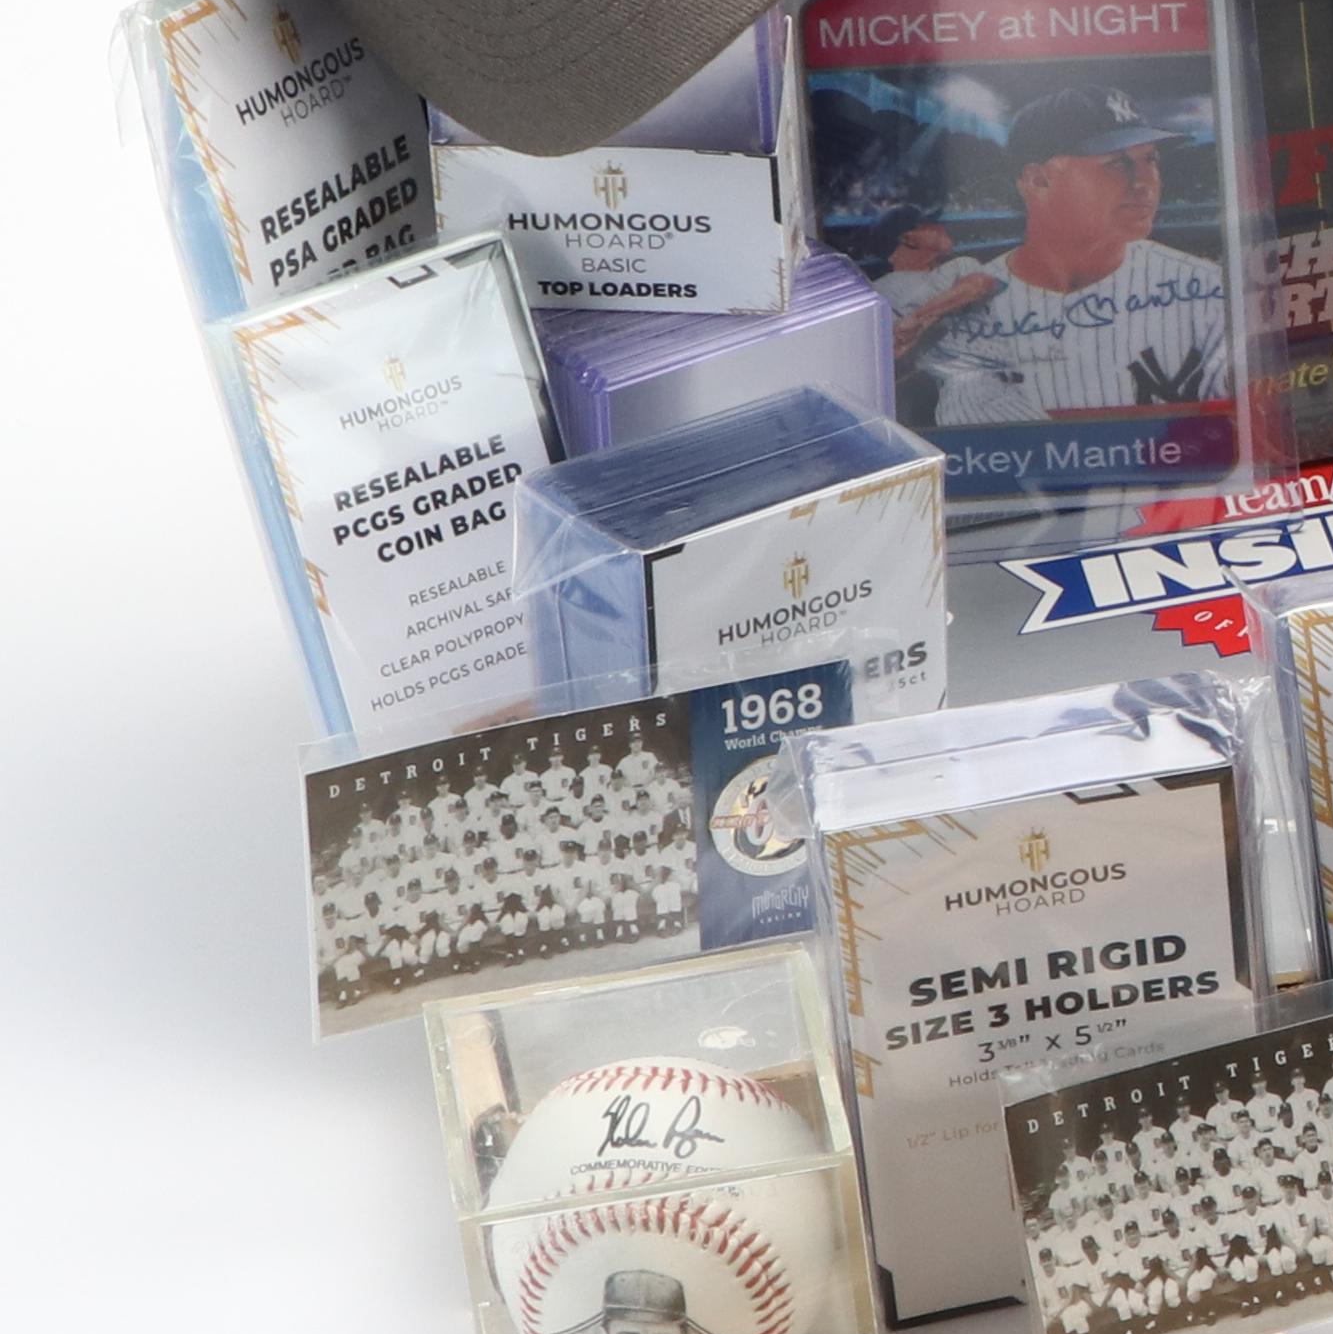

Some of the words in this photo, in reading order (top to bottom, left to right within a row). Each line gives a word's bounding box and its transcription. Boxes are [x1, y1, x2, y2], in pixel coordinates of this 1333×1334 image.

[819, 11, 986, 50] MICKEY
[998, 10, 1035, 40] at
[1049, 2, 1188, 36] NIGHT
[236, 37, 366, 125] HUMONGOUS
[260, 135, 411, 244] RESEALABLE
[269, 240, 318, 287] PSA
[322, 177, 418, 252] GRADED
[508, 212, 712, 234] HUMONGOUS
[538, 279, 584, 296] TOP
[589, 281, 698, 298] LOADERS
[582, 257, 647, 275] BASIC
[339, 375, 463, 431] HUMONGOUS
[333, 433, 507, 512] RESEALABLE
[1045, 437, 1183, 469] Mantle
[333, 505, 405, 546] PCGS
[412, 462, 523, 517] GRADED
[376, 527, 444, 564] COIN
[453, 500, 508, 537] BAG
[408, 560, 507, 607] RESEALABLE
[406, 600, 482, 639] ARCHIVAL
[718, 580, 873, 646] HUMONGOUS
[371, 679, 425, 714] HOLDS
[429, 663, 471, 690] PCGS
[380, 649, 431, 678] CLEAR
[721, 683, 823, 734] 1968
[328, 745, 493, 799] DETROIT
[527, 713, 668, 751] TIGERS
[724, 734, 766, 751] World
[944, 863, 1126, 912] HUMONGOUS
[995, 888, 1087, 917] HOARD
[909, 957, 1028, 1007] SEMI
[1047, 934, 1187, 981] RIGID
[885, 1011, 973, 1051] SIZE
[1025, 970, 1219, 1022] HOLDERS
[1026, 1074, 1192, 1134] DETROIT
[570, 1156, 682, 1176] COMMEMORATIVE
